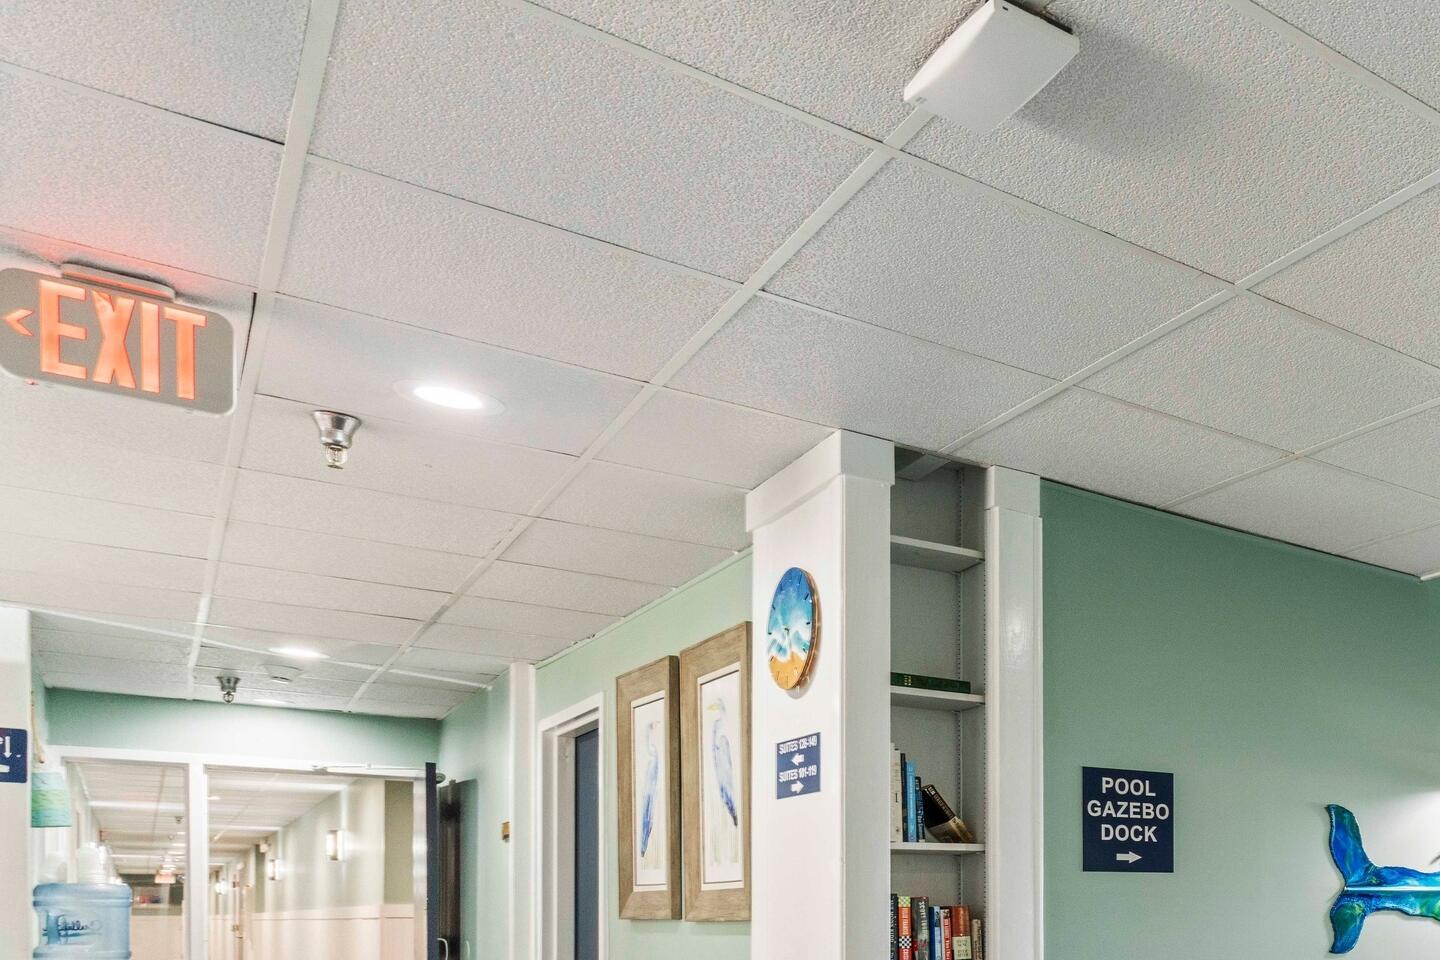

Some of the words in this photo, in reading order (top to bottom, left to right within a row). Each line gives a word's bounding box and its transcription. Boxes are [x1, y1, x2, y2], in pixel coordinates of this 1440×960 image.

[39, 279, 207, 400] EXIT
[779, 740, 798, 755] SUITES
[779, 769, 798, 783] SUITES
[1101, 776, 1156, 797] POOL
[1087, 799, 1169, 820] GAZEBO
[1101, 823, 1158, 842] DOCK
